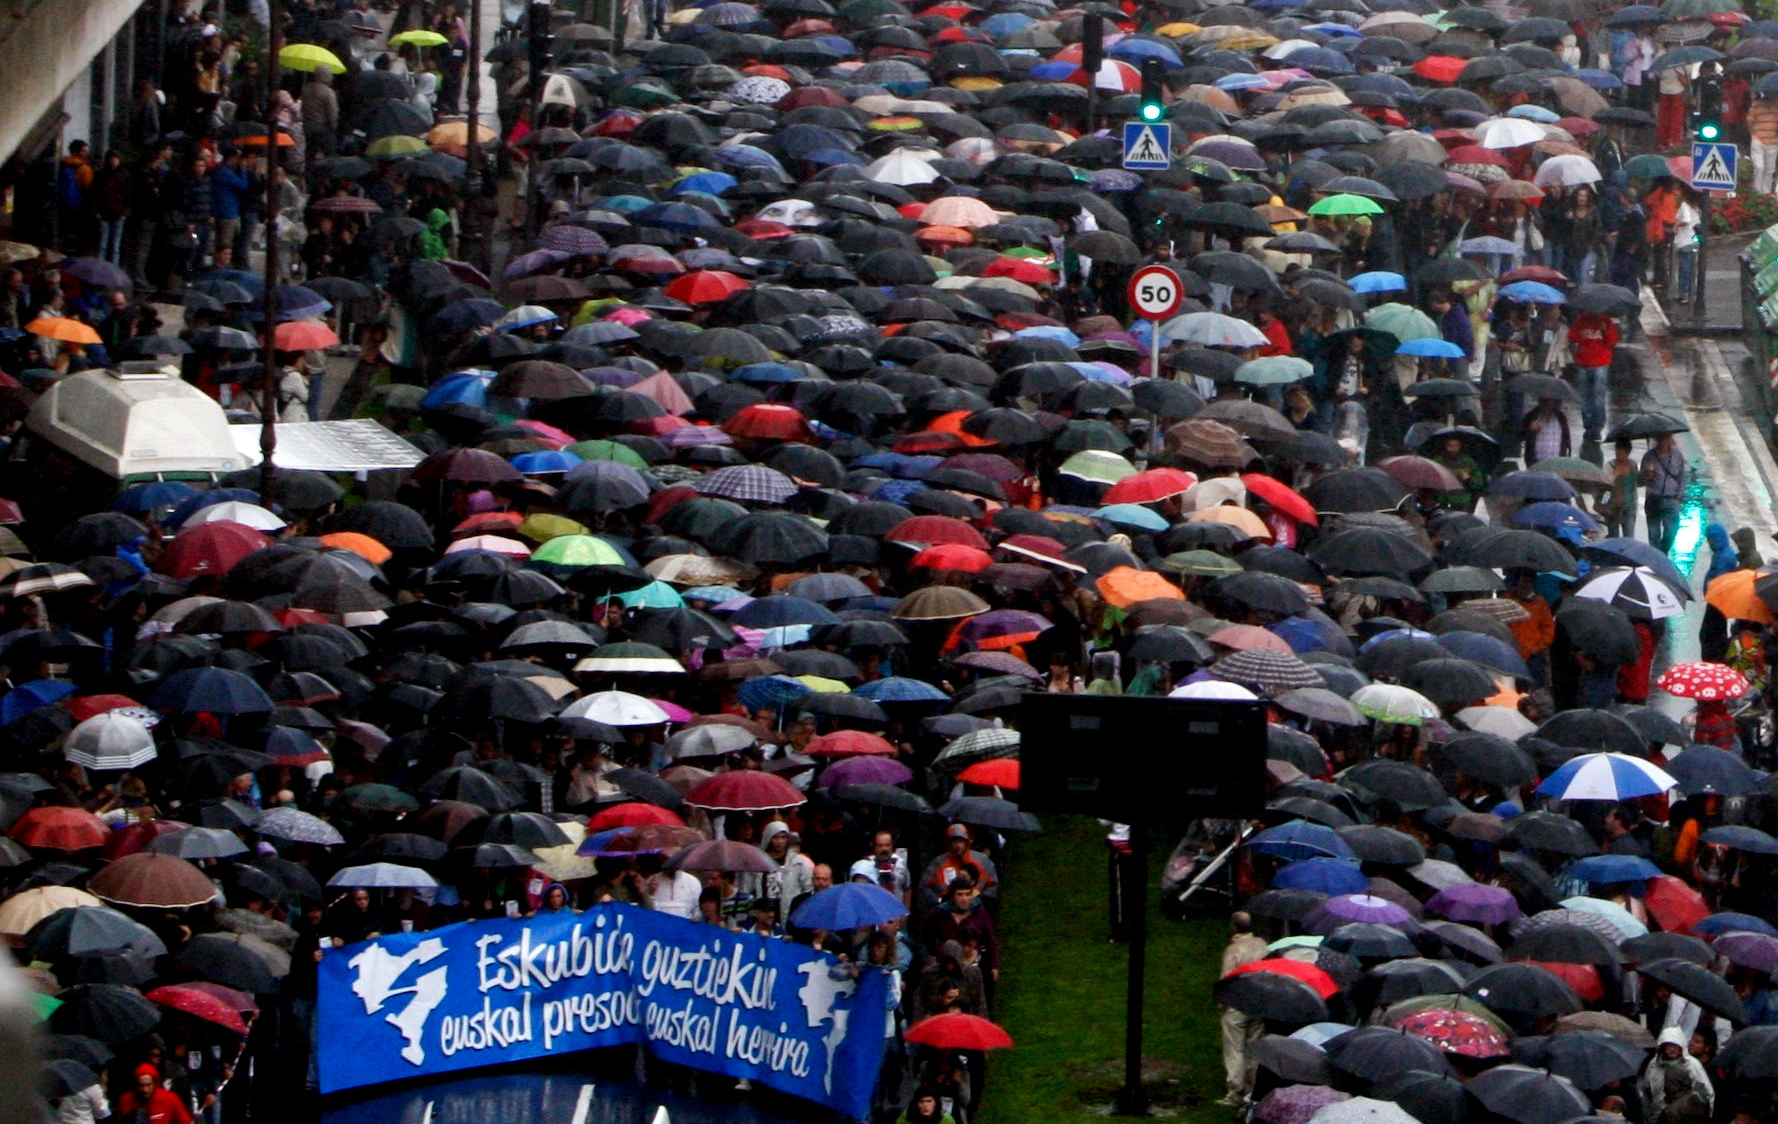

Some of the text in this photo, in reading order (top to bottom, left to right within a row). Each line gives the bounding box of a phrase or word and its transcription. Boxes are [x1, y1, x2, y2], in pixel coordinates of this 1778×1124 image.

[1141, 285, 1171, 303] 50
[637, 939, 777, 1011] guztiekin
[441, 991, 532, 1056] euskal
[646, 998, 721, 1055] euskal
[726, 1008, 809, 1077] herrira
